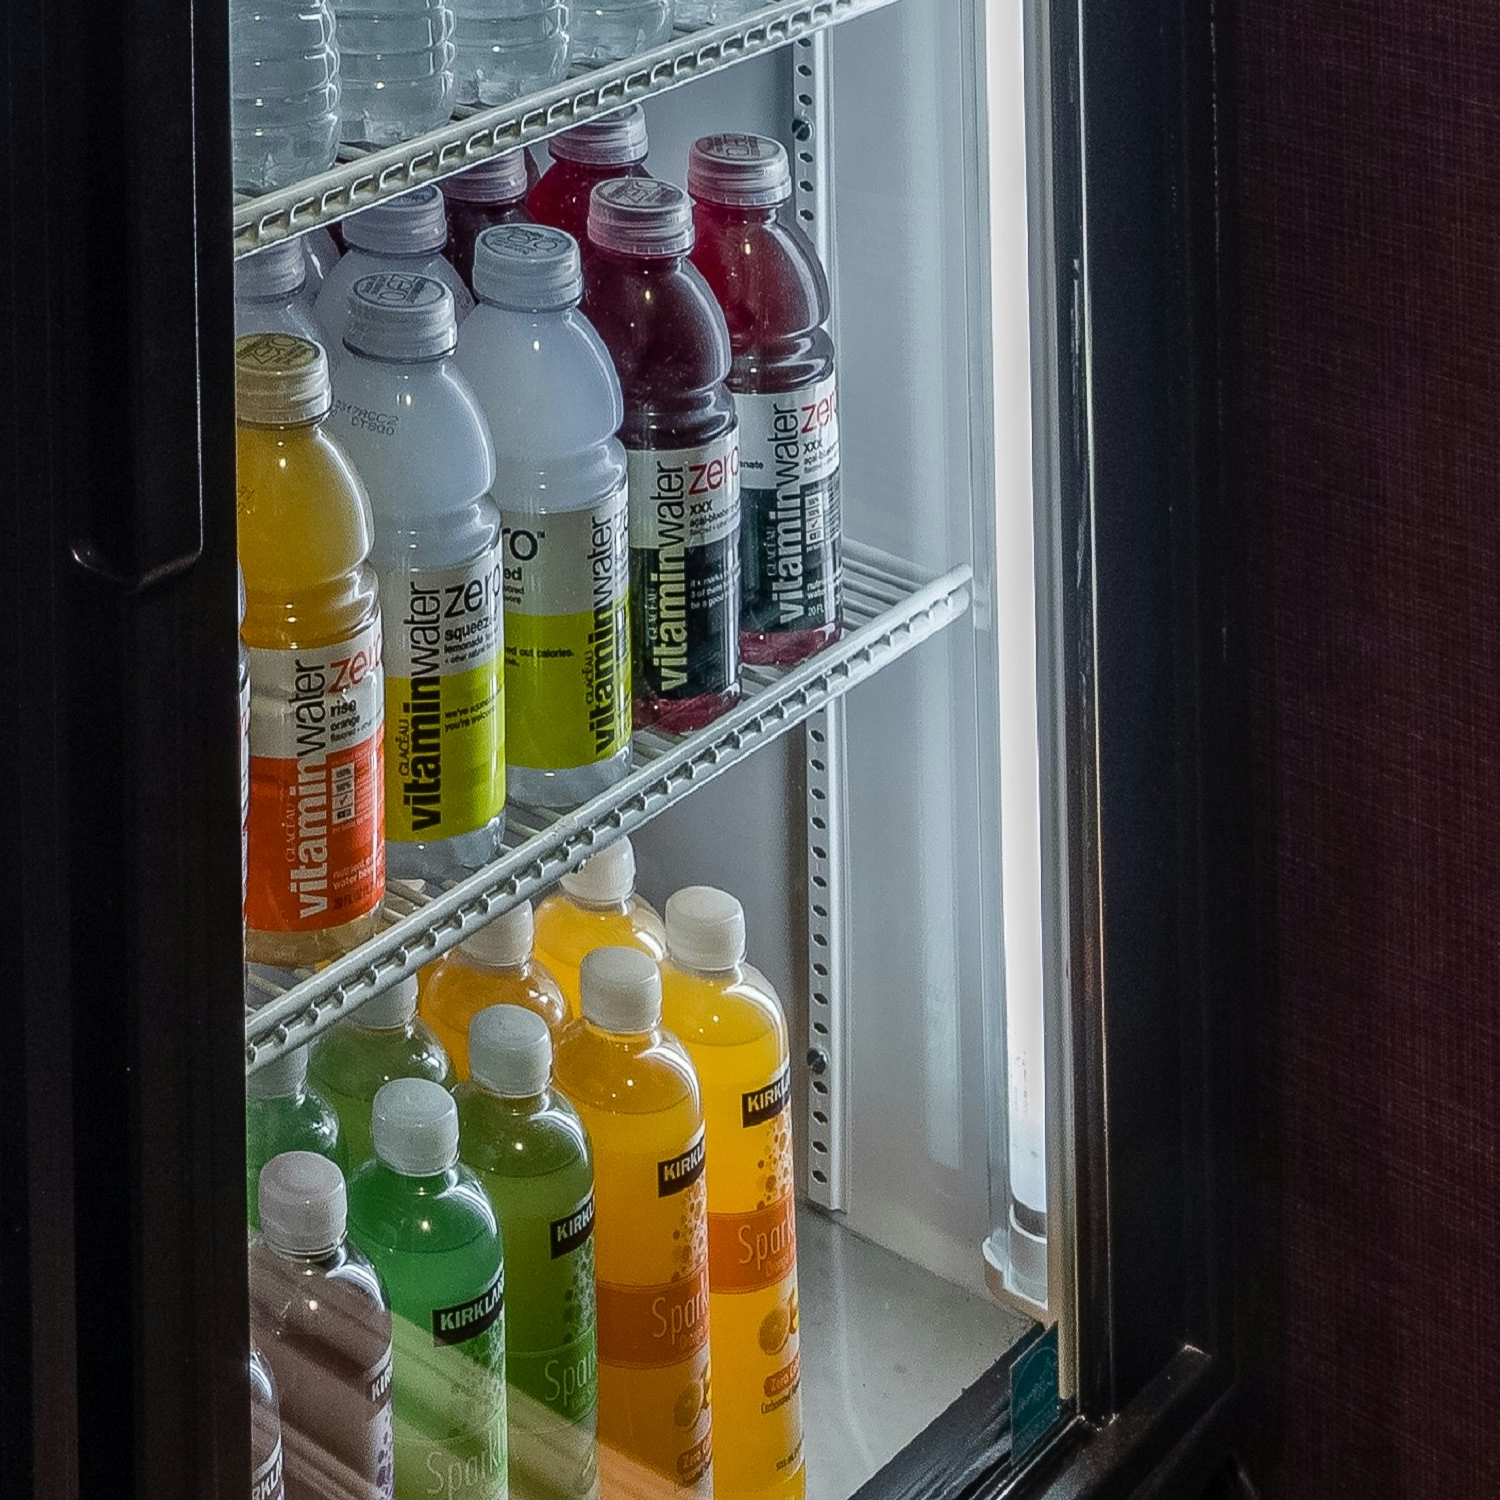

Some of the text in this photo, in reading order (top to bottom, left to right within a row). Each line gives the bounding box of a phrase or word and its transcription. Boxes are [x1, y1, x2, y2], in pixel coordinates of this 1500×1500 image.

[689, 446, 739, 495] zero
[768, 403, 804, 623] vitaminwater
[445, 562, 500, 618] zero
[650, 460, 688, 691] vitaminwater
[329, 634, 381, 694] zero
[330, 700, 357, 717] rise
[330, 715, 360, 731] orange
[404, 581, 441, 831] vitaminwater
[290, 659, 328, 918] vitaminwater
